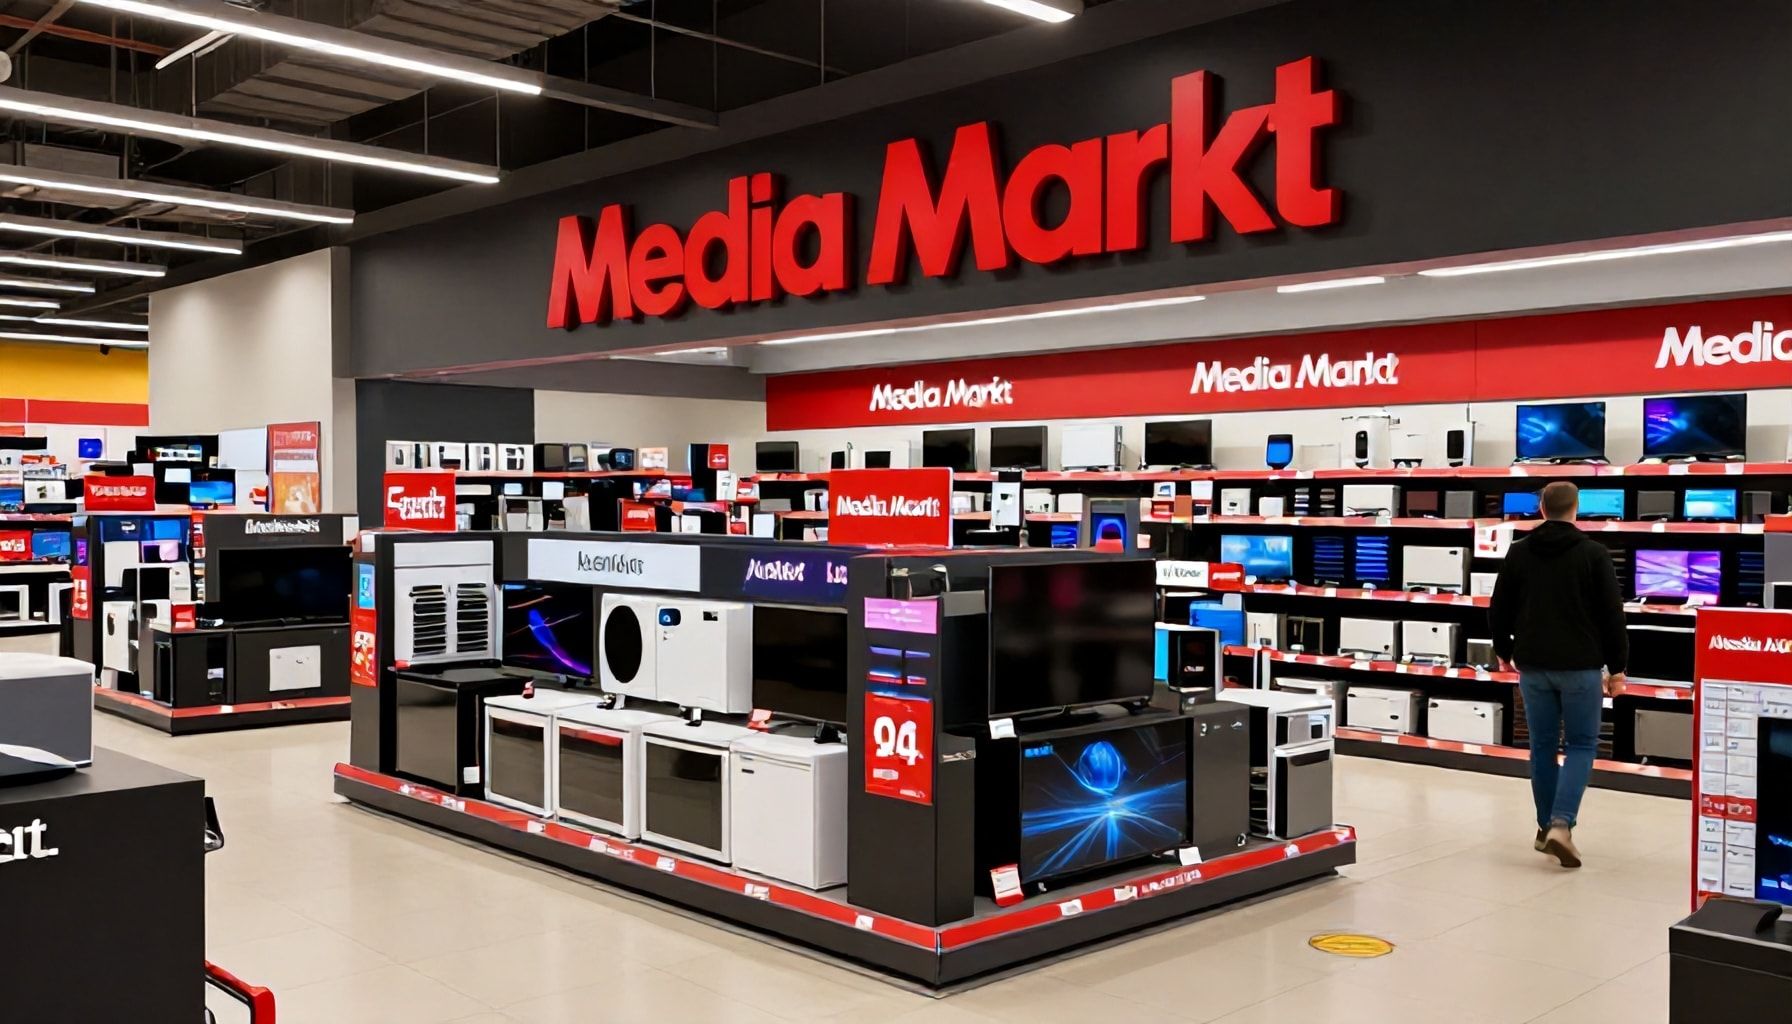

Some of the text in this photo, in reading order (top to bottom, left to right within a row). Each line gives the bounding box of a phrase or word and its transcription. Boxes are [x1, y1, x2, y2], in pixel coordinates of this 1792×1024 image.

[546, 55, 1342, 329] Media Markt
[1189, 356, 1292, 394] Media
